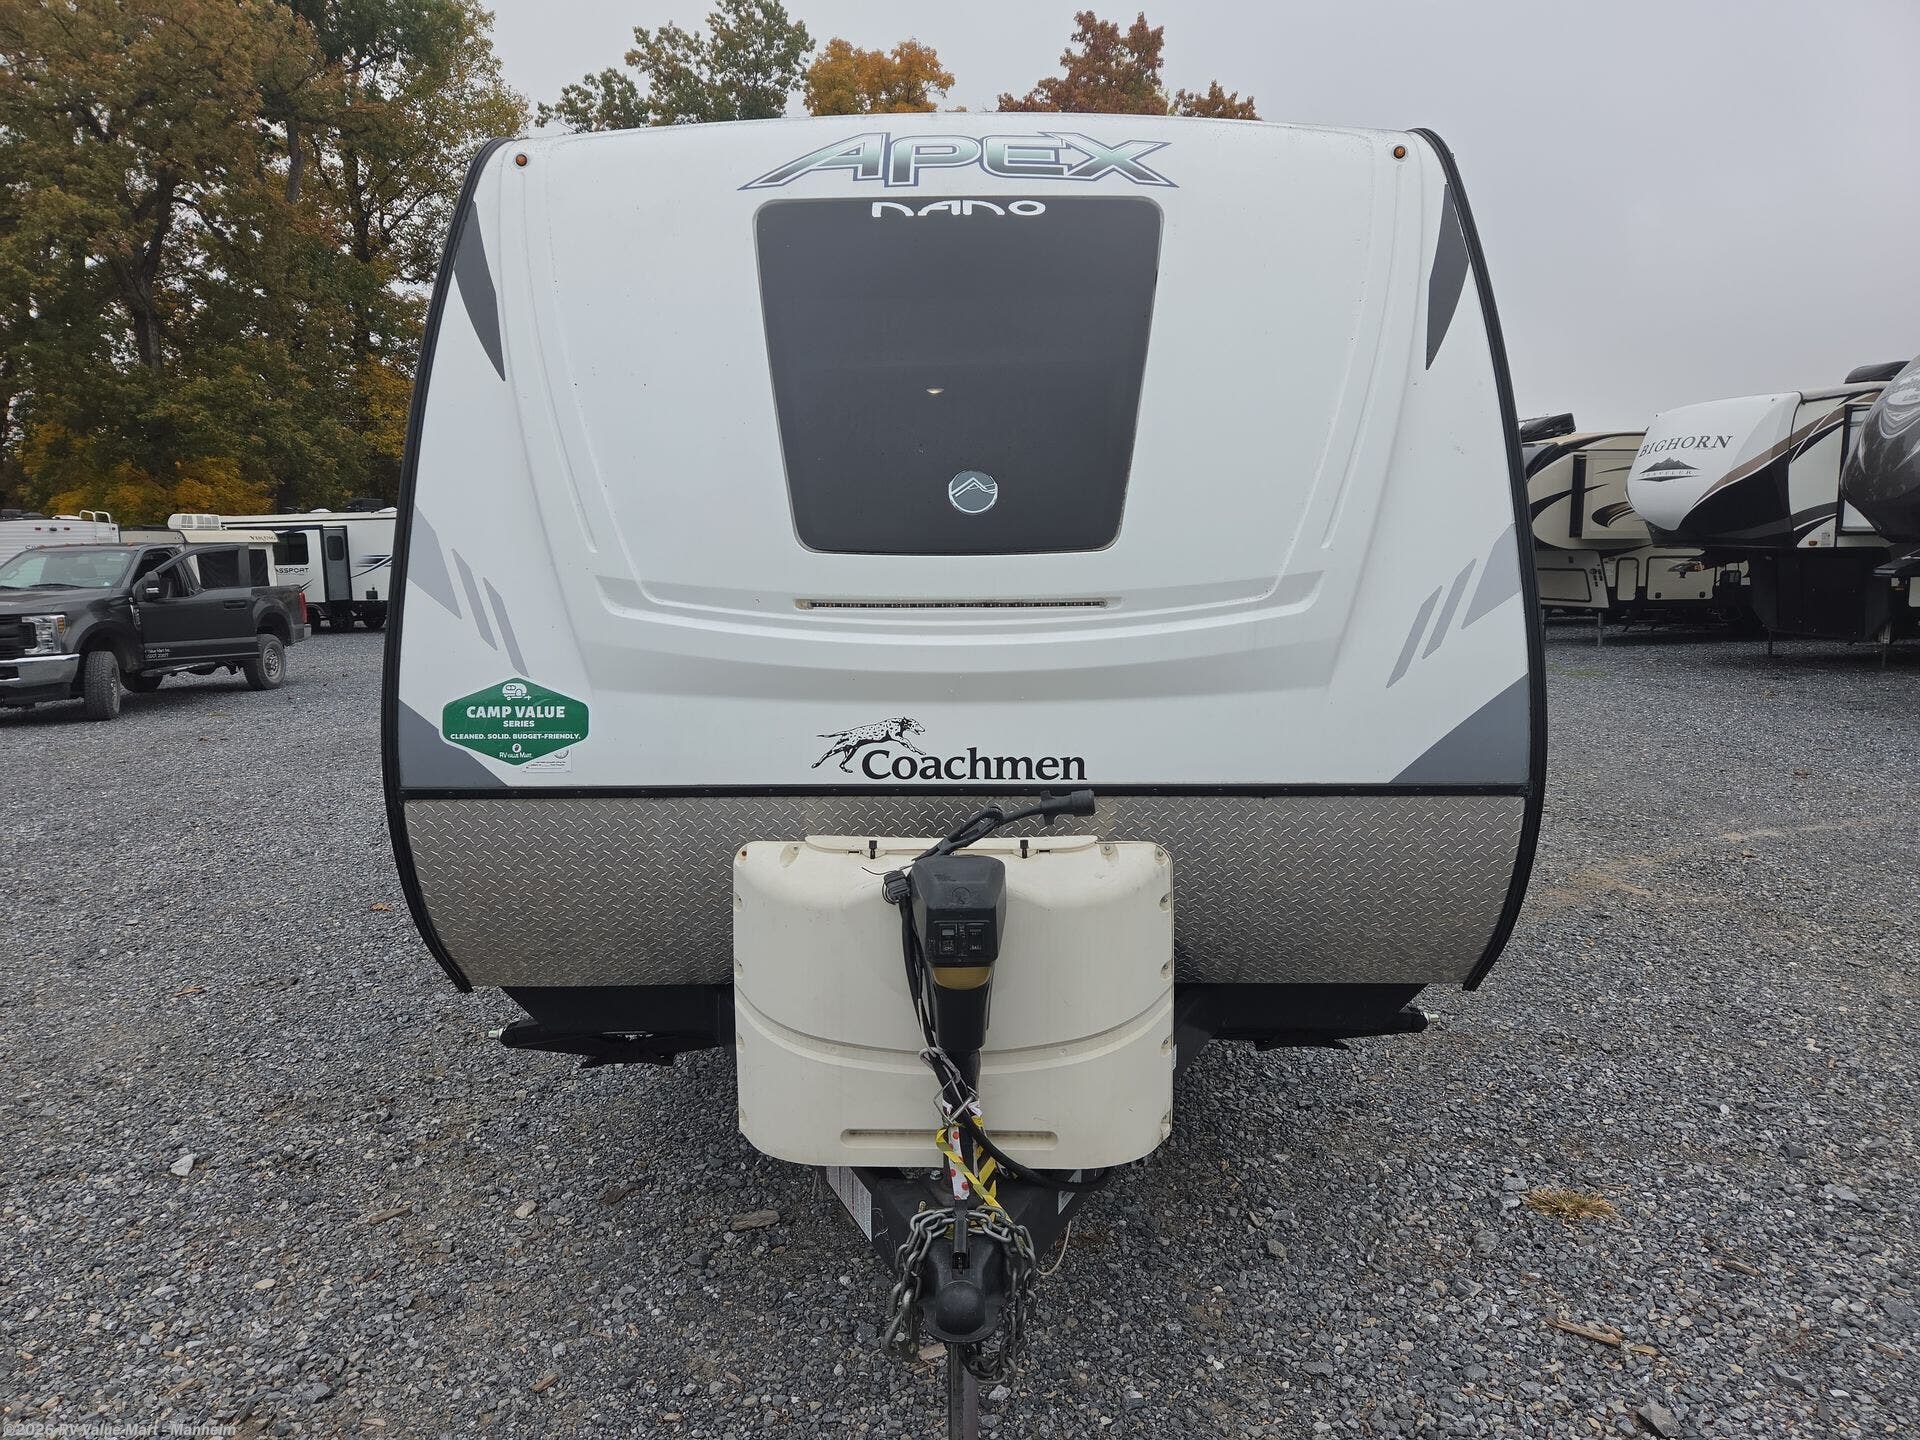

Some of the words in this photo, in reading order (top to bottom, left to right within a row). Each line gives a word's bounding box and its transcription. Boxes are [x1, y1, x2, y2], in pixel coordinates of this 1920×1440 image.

[737, 132, 1179, 190] APEX
[1639, 435, 1733, 457] BIGHORN
[466, 705, 512, 718] CAMP
[514, 705, 566, 718] VALUE
[503, 720, 535, 728] SERIES
[862, 747, 1087, 780] Coachmen
